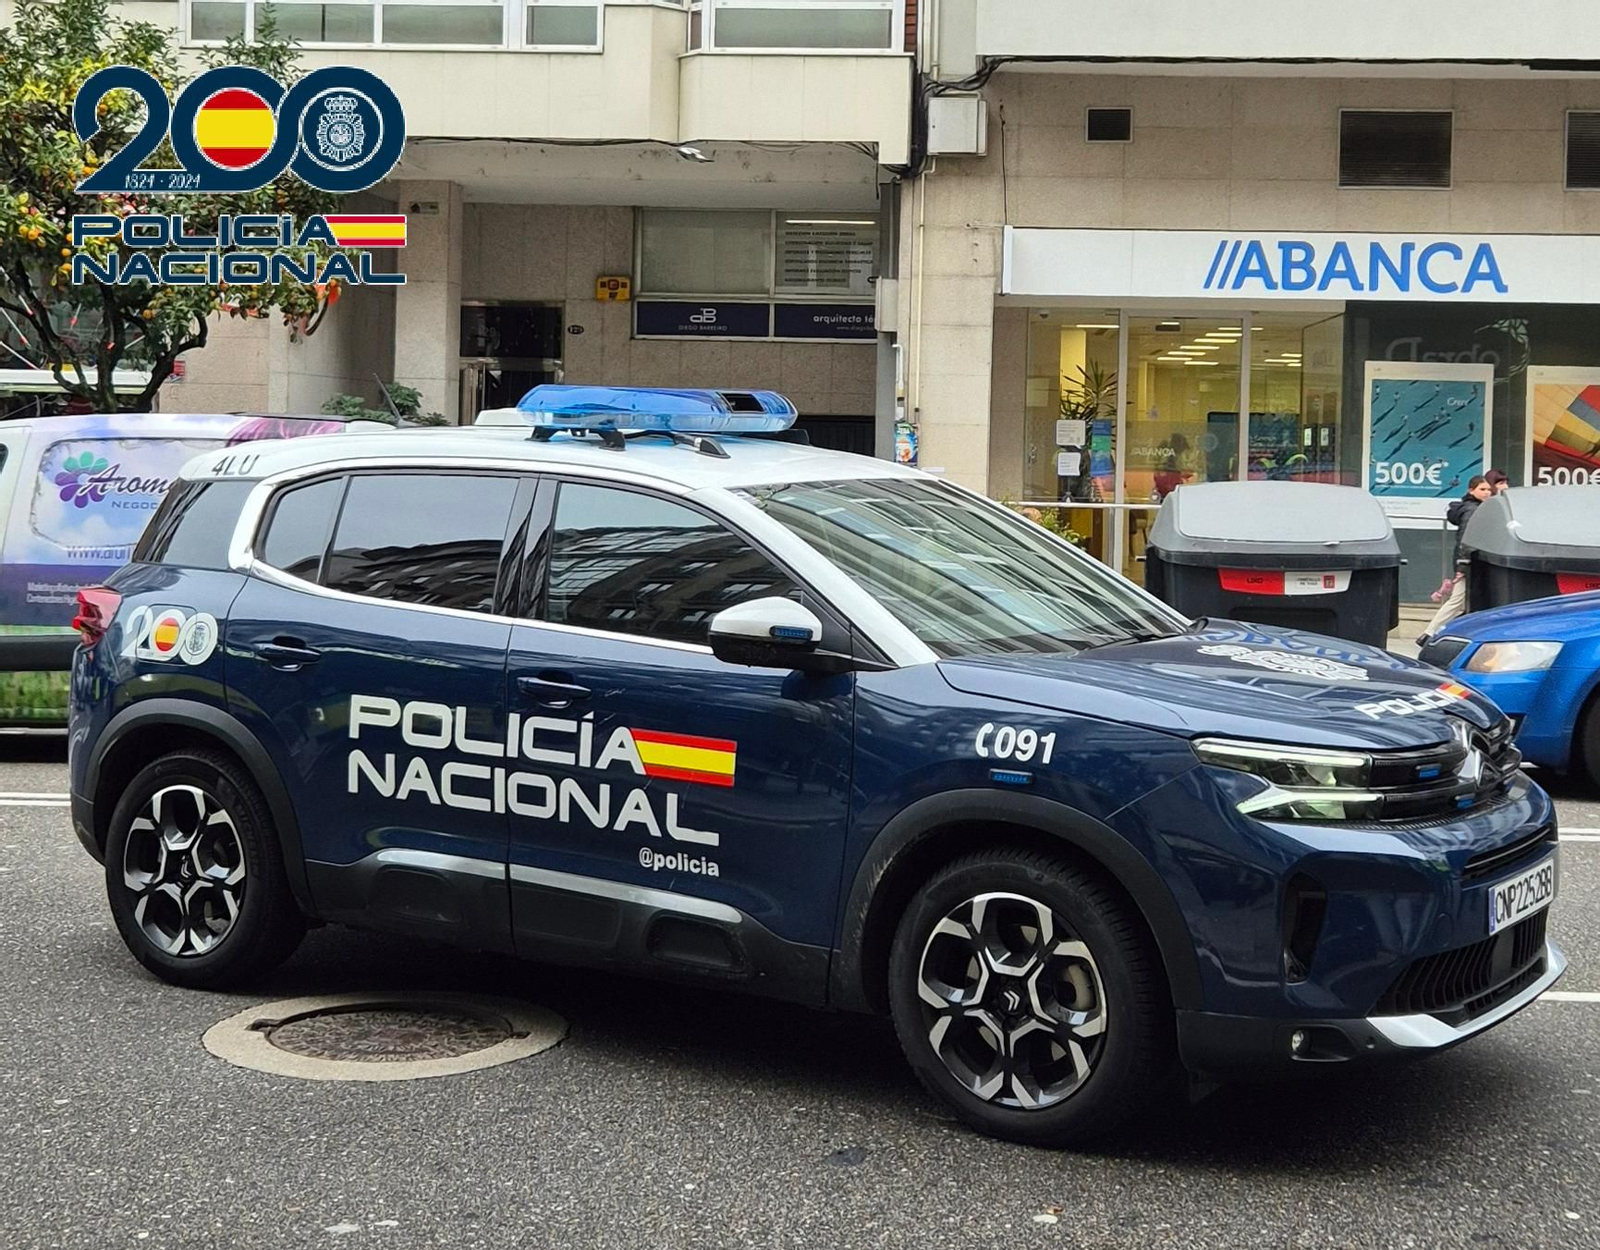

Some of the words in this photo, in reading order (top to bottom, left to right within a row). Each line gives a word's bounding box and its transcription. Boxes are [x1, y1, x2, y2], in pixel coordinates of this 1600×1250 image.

[813, 313, 862, 324] arquitecto
[120, 605, 218, 666] 200
[994, 726, 1056, 765] 091
[347, 749, 720, 846] NACIONAL
[638, 846, 720, 878] @policia
